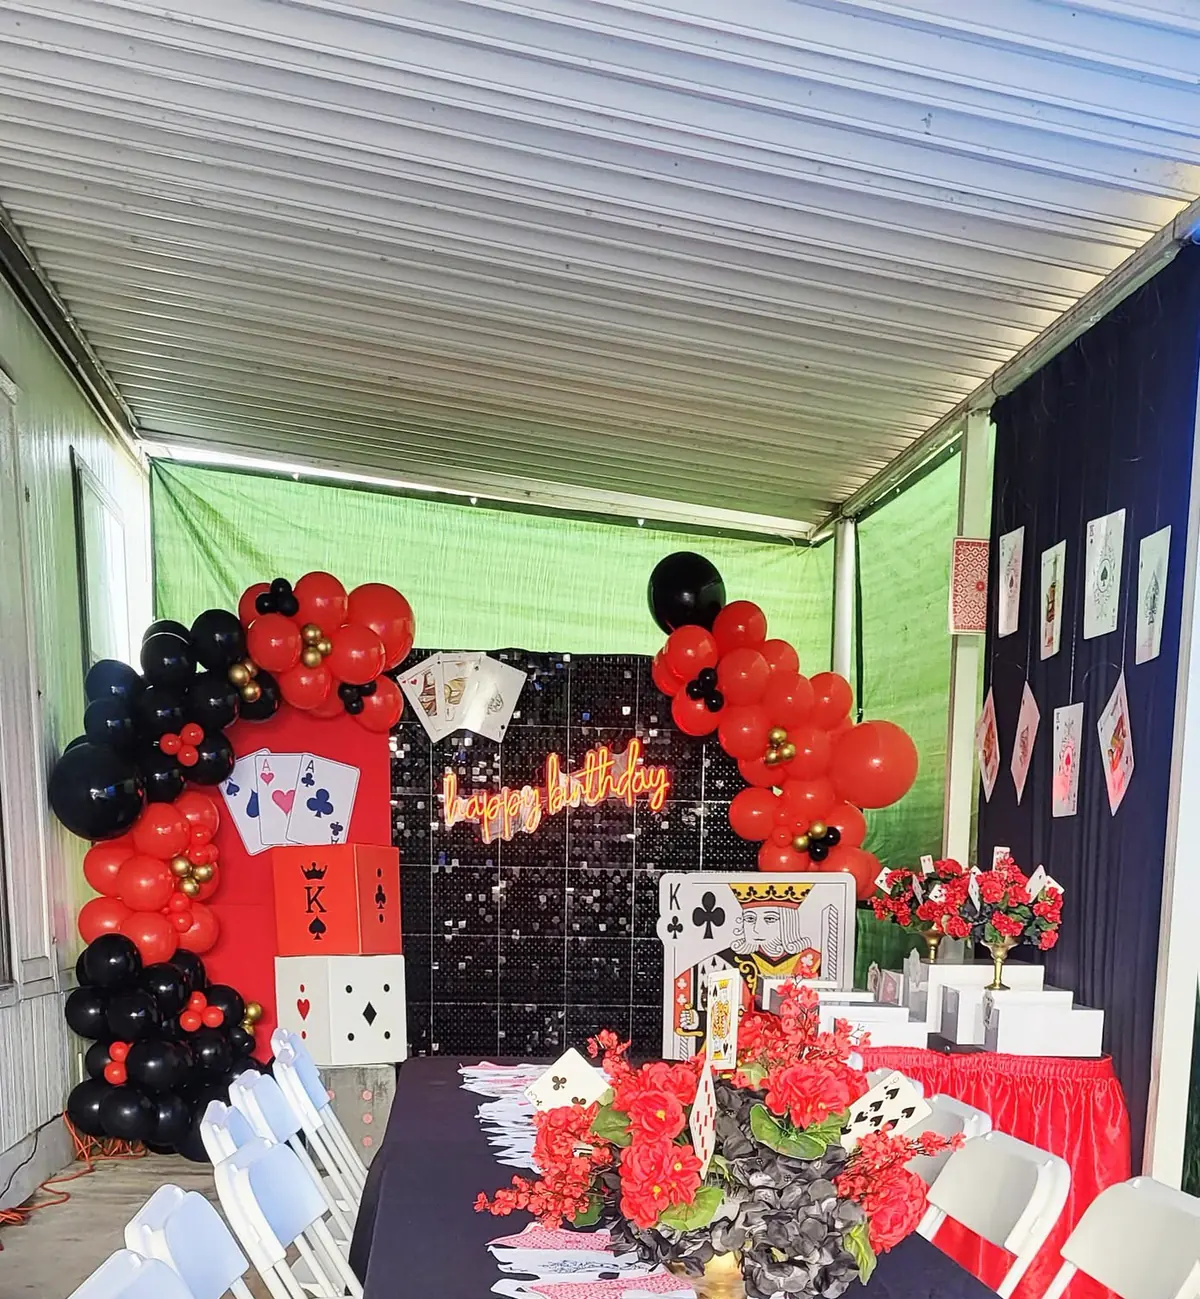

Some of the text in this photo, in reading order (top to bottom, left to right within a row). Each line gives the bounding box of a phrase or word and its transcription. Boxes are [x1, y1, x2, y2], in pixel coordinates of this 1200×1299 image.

[262, 759, 271, 772] A
[305, 760, 315, 773] A
[443, 738, 670, 844] happy birthday
[304, 886, 328, 913] K
[670, 883, 681, 910] K
